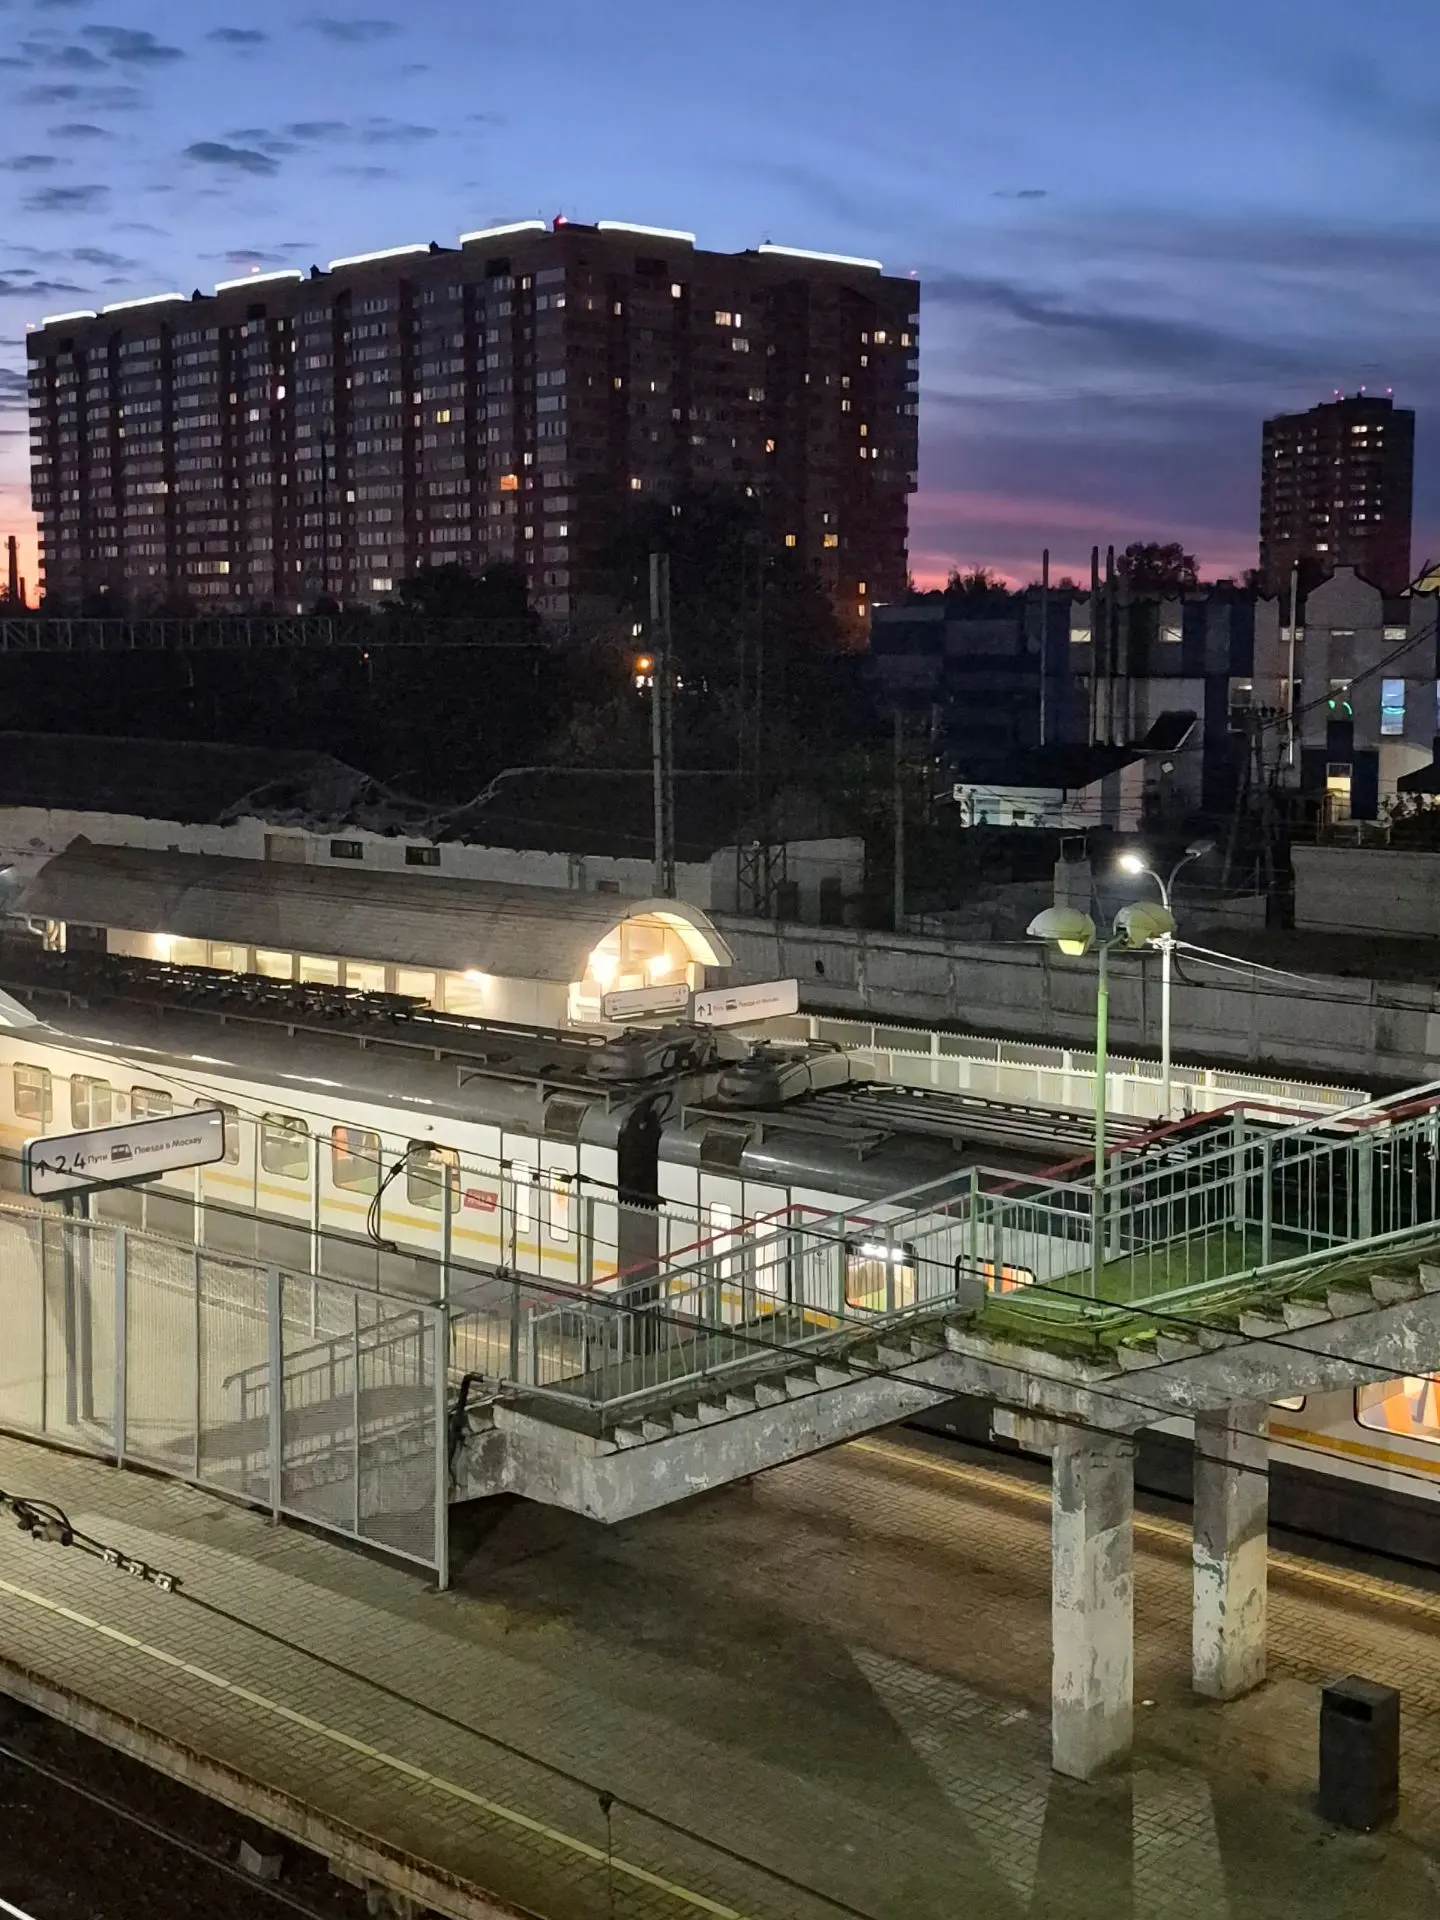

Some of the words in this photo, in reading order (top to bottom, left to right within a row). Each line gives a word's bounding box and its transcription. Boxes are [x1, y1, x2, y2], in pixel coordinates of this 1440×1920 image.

[707, 1003, 713, 1016] 1
[54, 1152, 86, 1173] 2,4
[88, 1154, 108, 1164] Пути
[135, 1144, 164, 1154] Поезда
[172, 1136, 202, 1148] Москву
